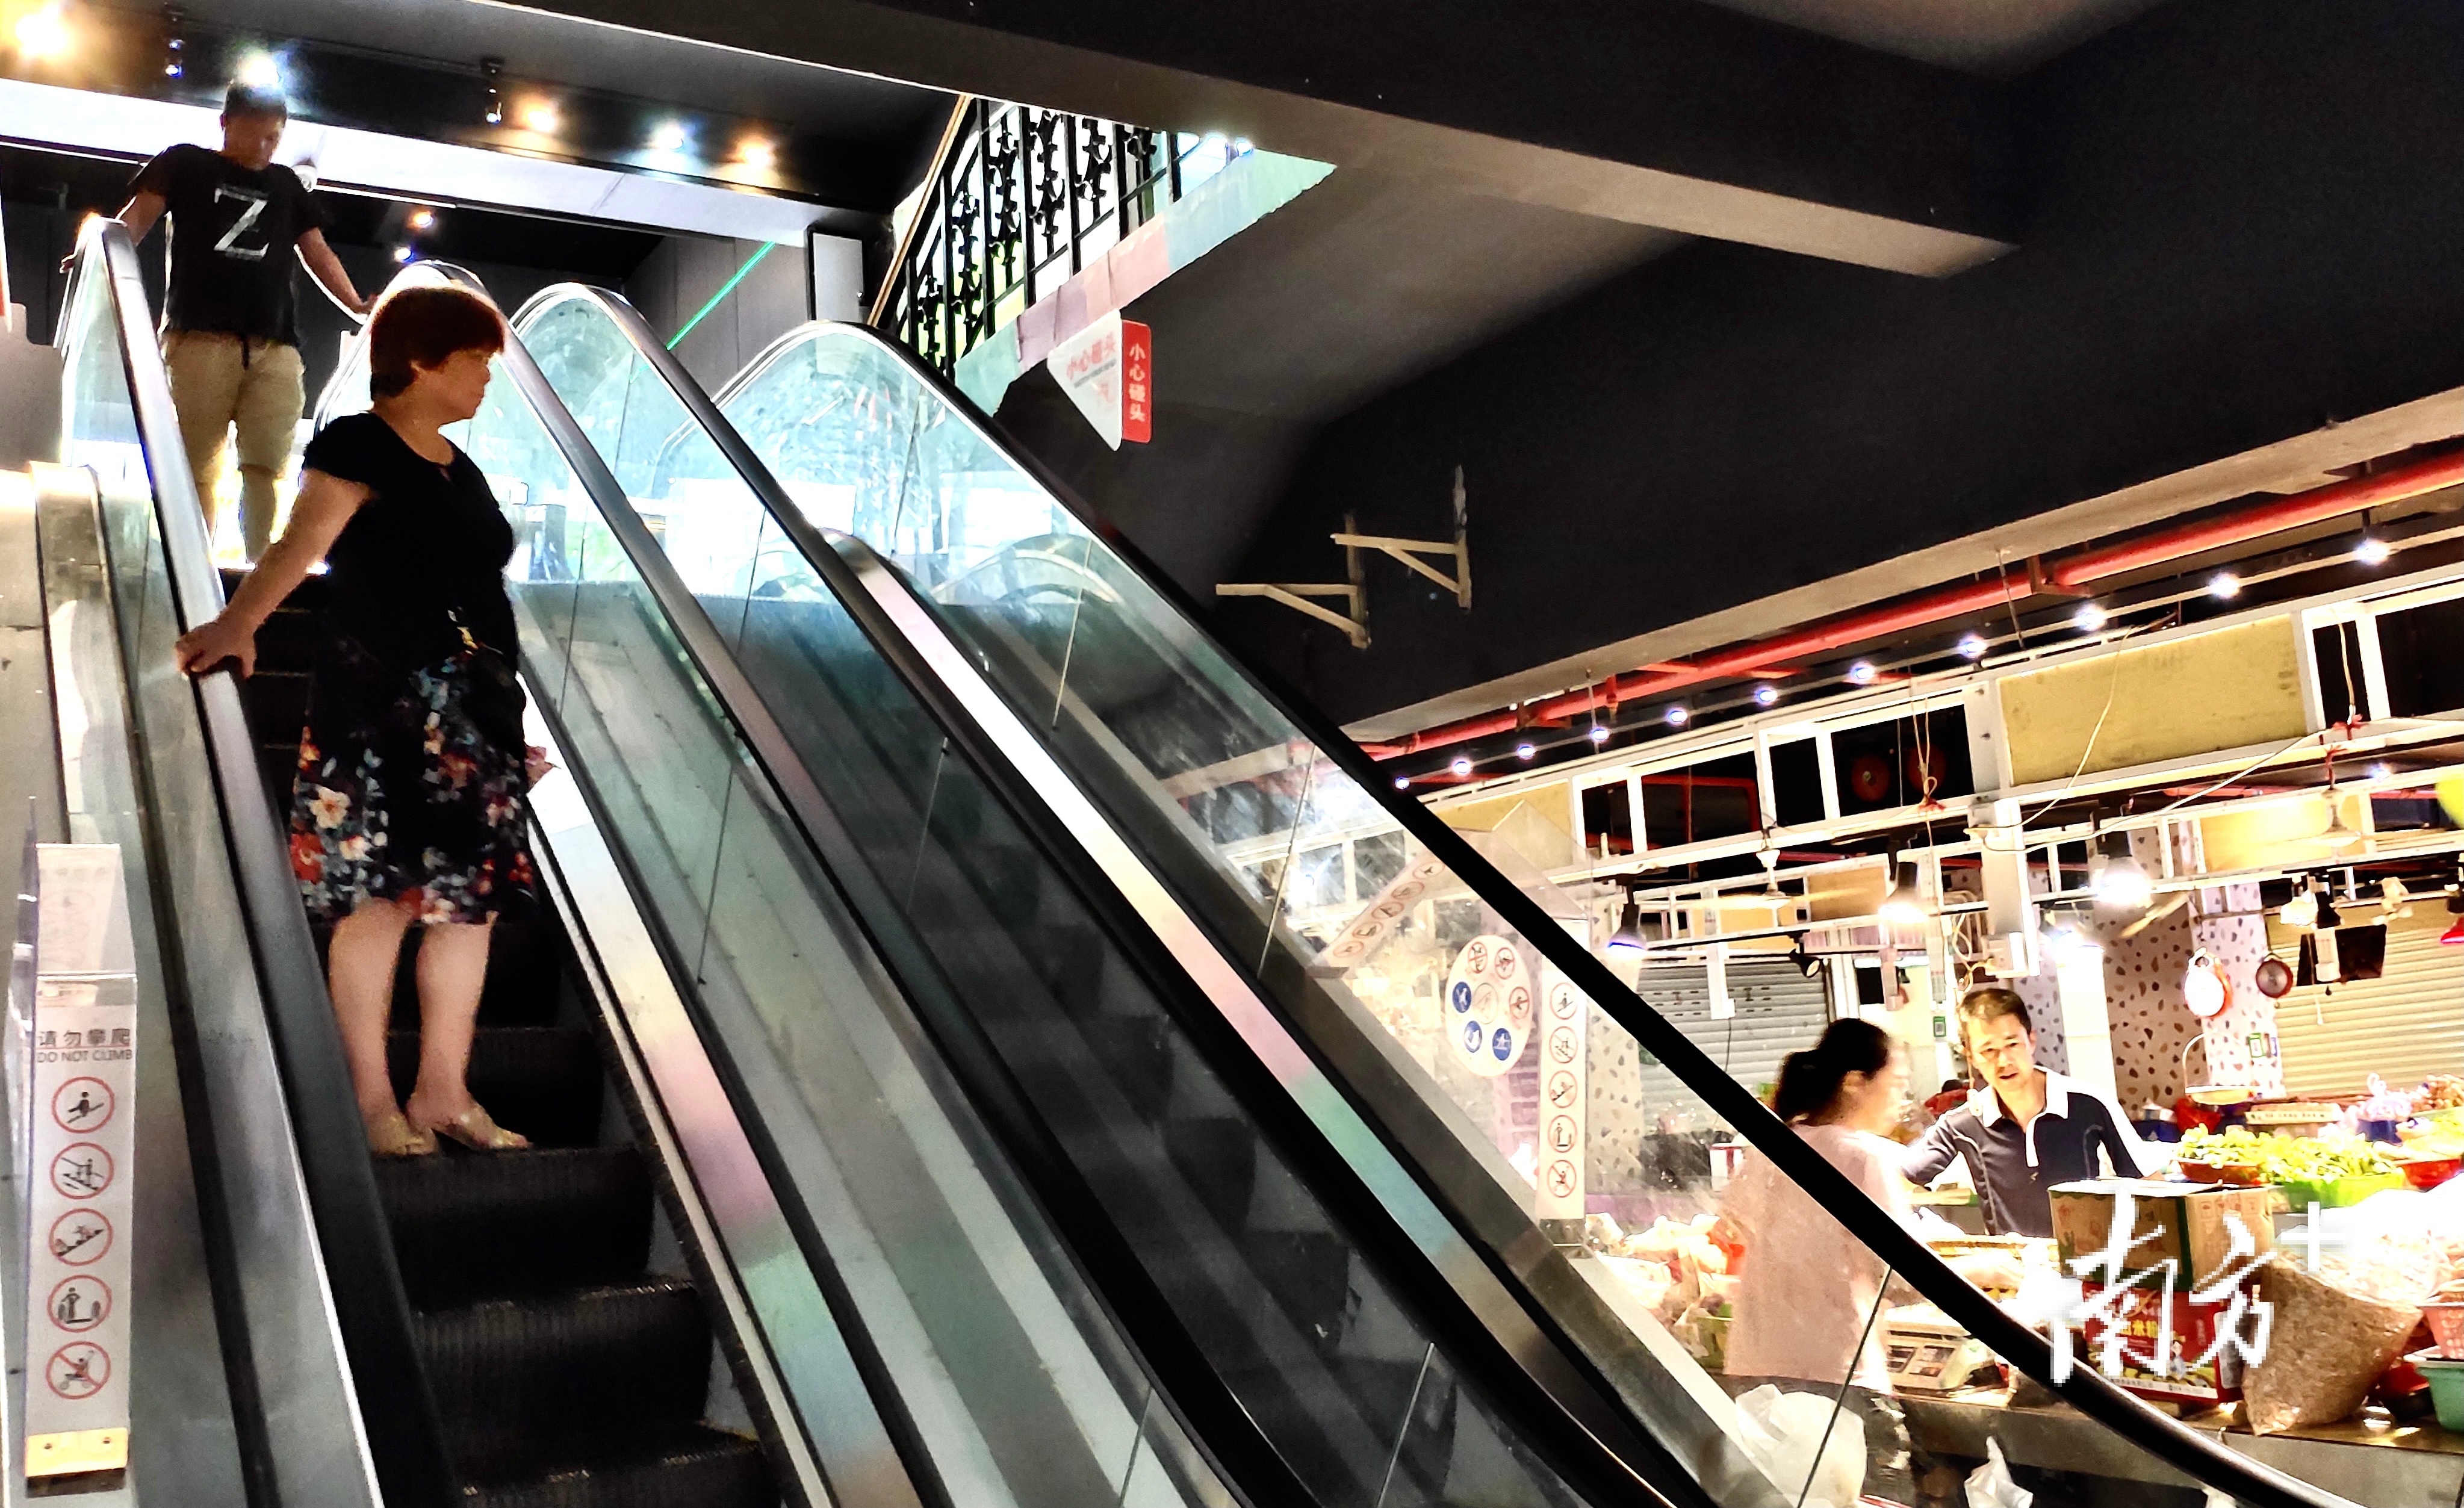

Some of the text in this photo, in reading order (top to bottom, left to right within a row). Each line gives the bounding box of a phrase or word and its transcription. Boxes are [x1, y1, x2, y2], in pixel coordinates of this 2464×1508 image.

[214, 184, 269, 262] Z
[37, 1049, 132, 1063] DO NOT CLIMB
